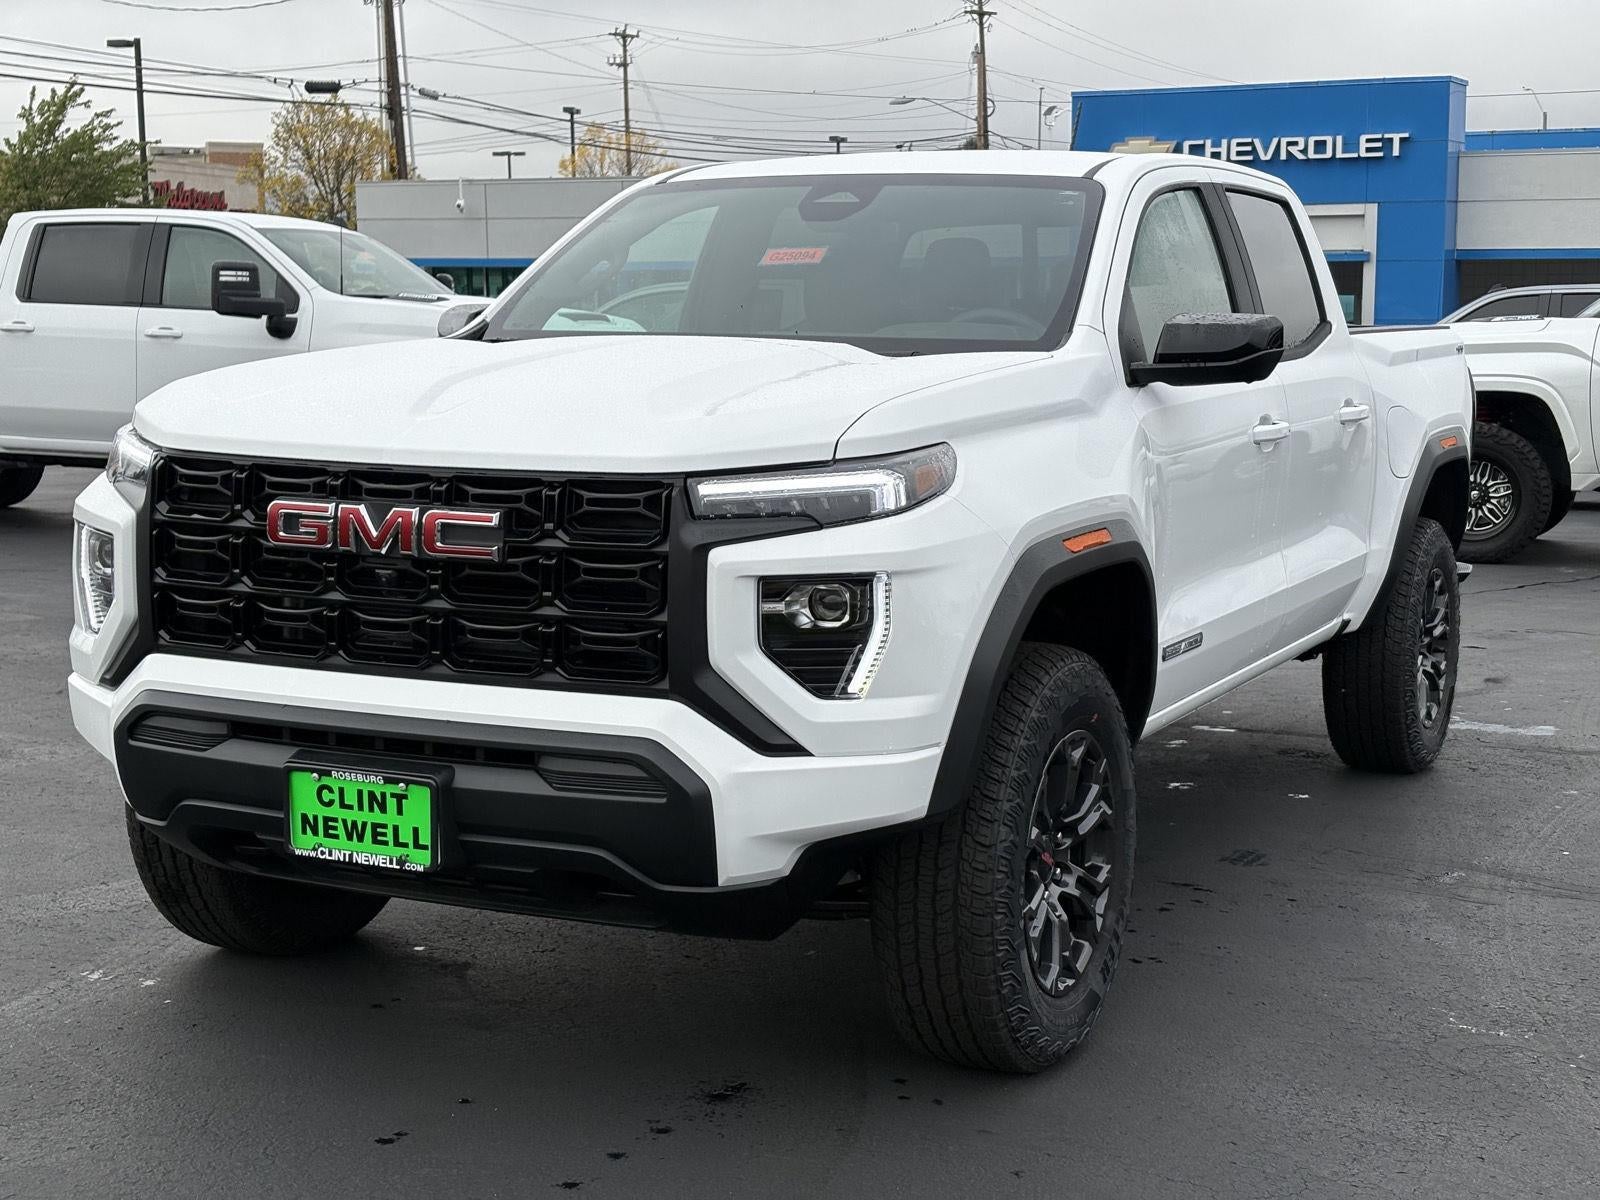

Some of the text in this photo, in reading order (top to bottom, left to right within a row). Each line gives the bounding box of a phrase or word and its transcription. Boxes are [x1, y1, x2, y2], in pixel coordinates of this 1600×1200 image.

[1183, 132, 1410, 161] CHEVROLET
[266, 499, 501, 562] GMC
[331, 770, 384, 784] ROSEBURG
[315, 783, 409, 817] CLINT
[300, 812, 430, 851] NEWELL
[352, 852, 401, 869] NEWELL
